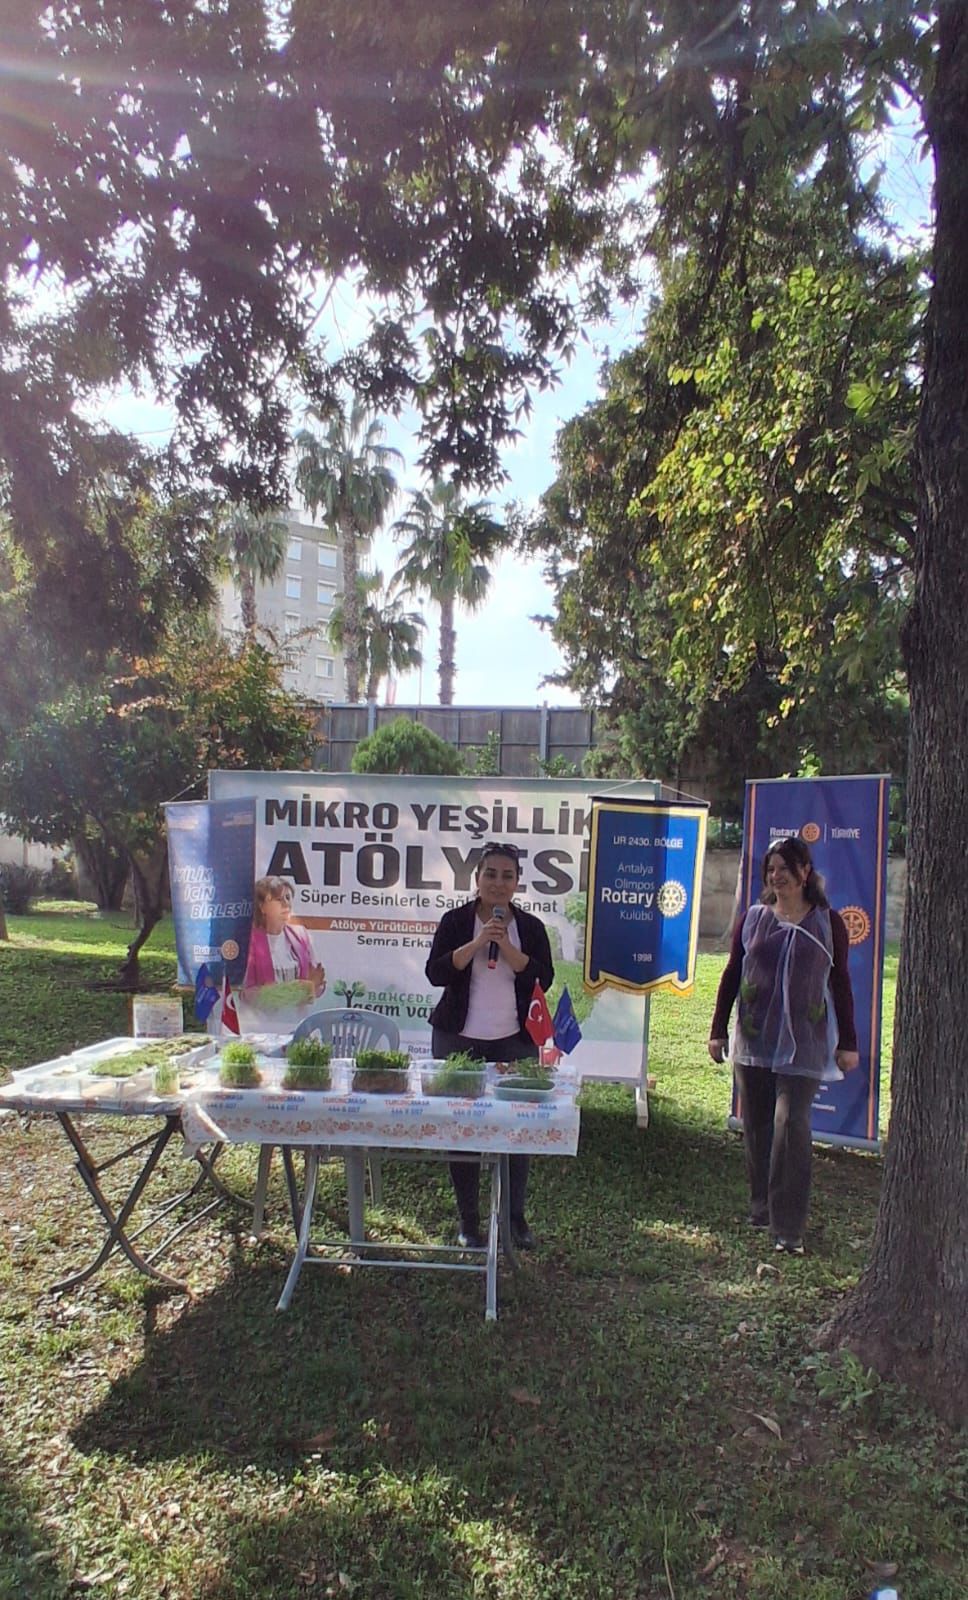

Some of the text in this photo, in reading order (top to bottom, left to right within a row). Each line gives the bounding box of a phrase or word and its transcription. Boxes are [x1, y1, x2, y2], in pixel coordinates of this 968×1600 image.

[265, 794, 399, 829] MİKRO
[654, 837, 683, 849] BÖLGE
[617, 862, 654, 876] Antalya
[614, 878, 655, 891] Olimpos
[301, 889, 346, 906] Süper
[351, 891, 430, 907] Besinlerle
[601, 887, 654, 908] Rotary
[620, 909, 653, 921] Kulübü
[330, 919, 366, 933] Atölye
[357, 935, 399, 947] Semra
[632, 953, 652, 962] 1998
